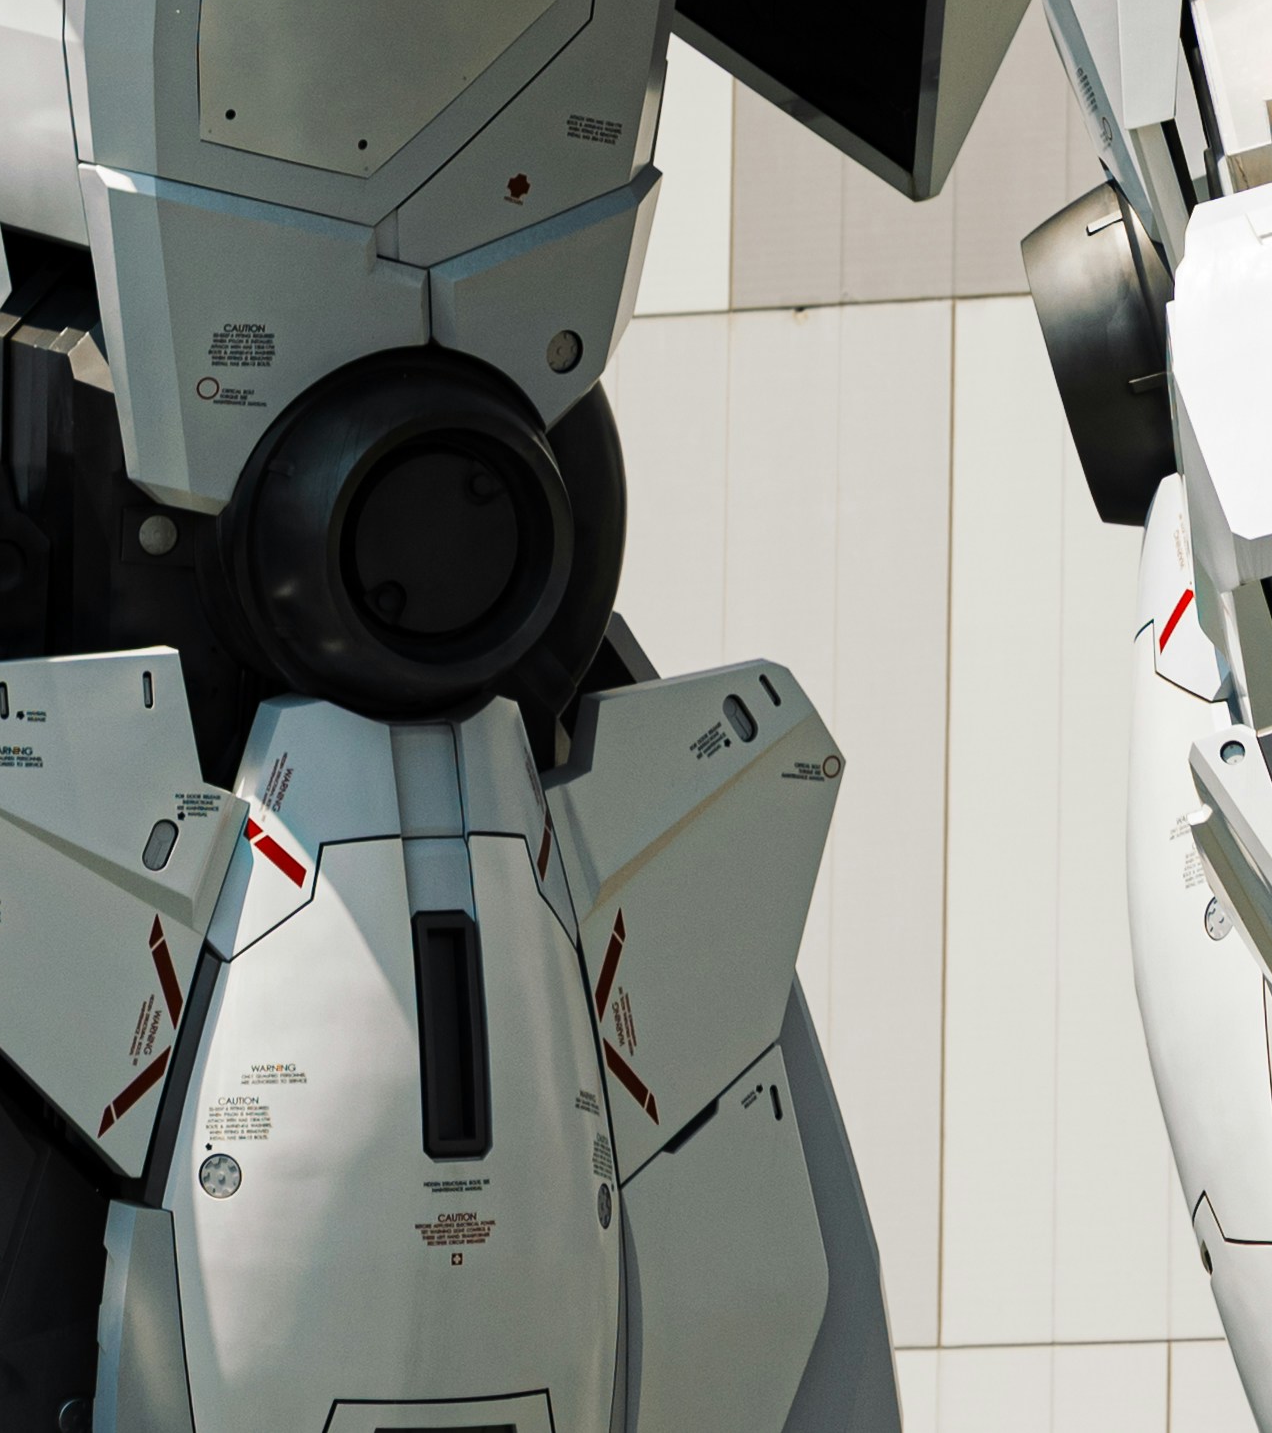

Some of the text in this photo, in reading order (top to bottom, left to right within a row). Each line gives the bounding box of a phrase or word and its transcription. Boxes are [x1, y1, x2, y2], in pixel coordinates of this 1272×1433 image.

[223, 324, 266, 335] CAUTION
[272, 768, 294, 813] WARNING
[144, 1010, 162, 1055] WARNING
[251, 1063, 296, 1072] WARNING
[218, 1096, 259, 1107] CAUTION
[437, 1212, 477, 1224] CAUTION
